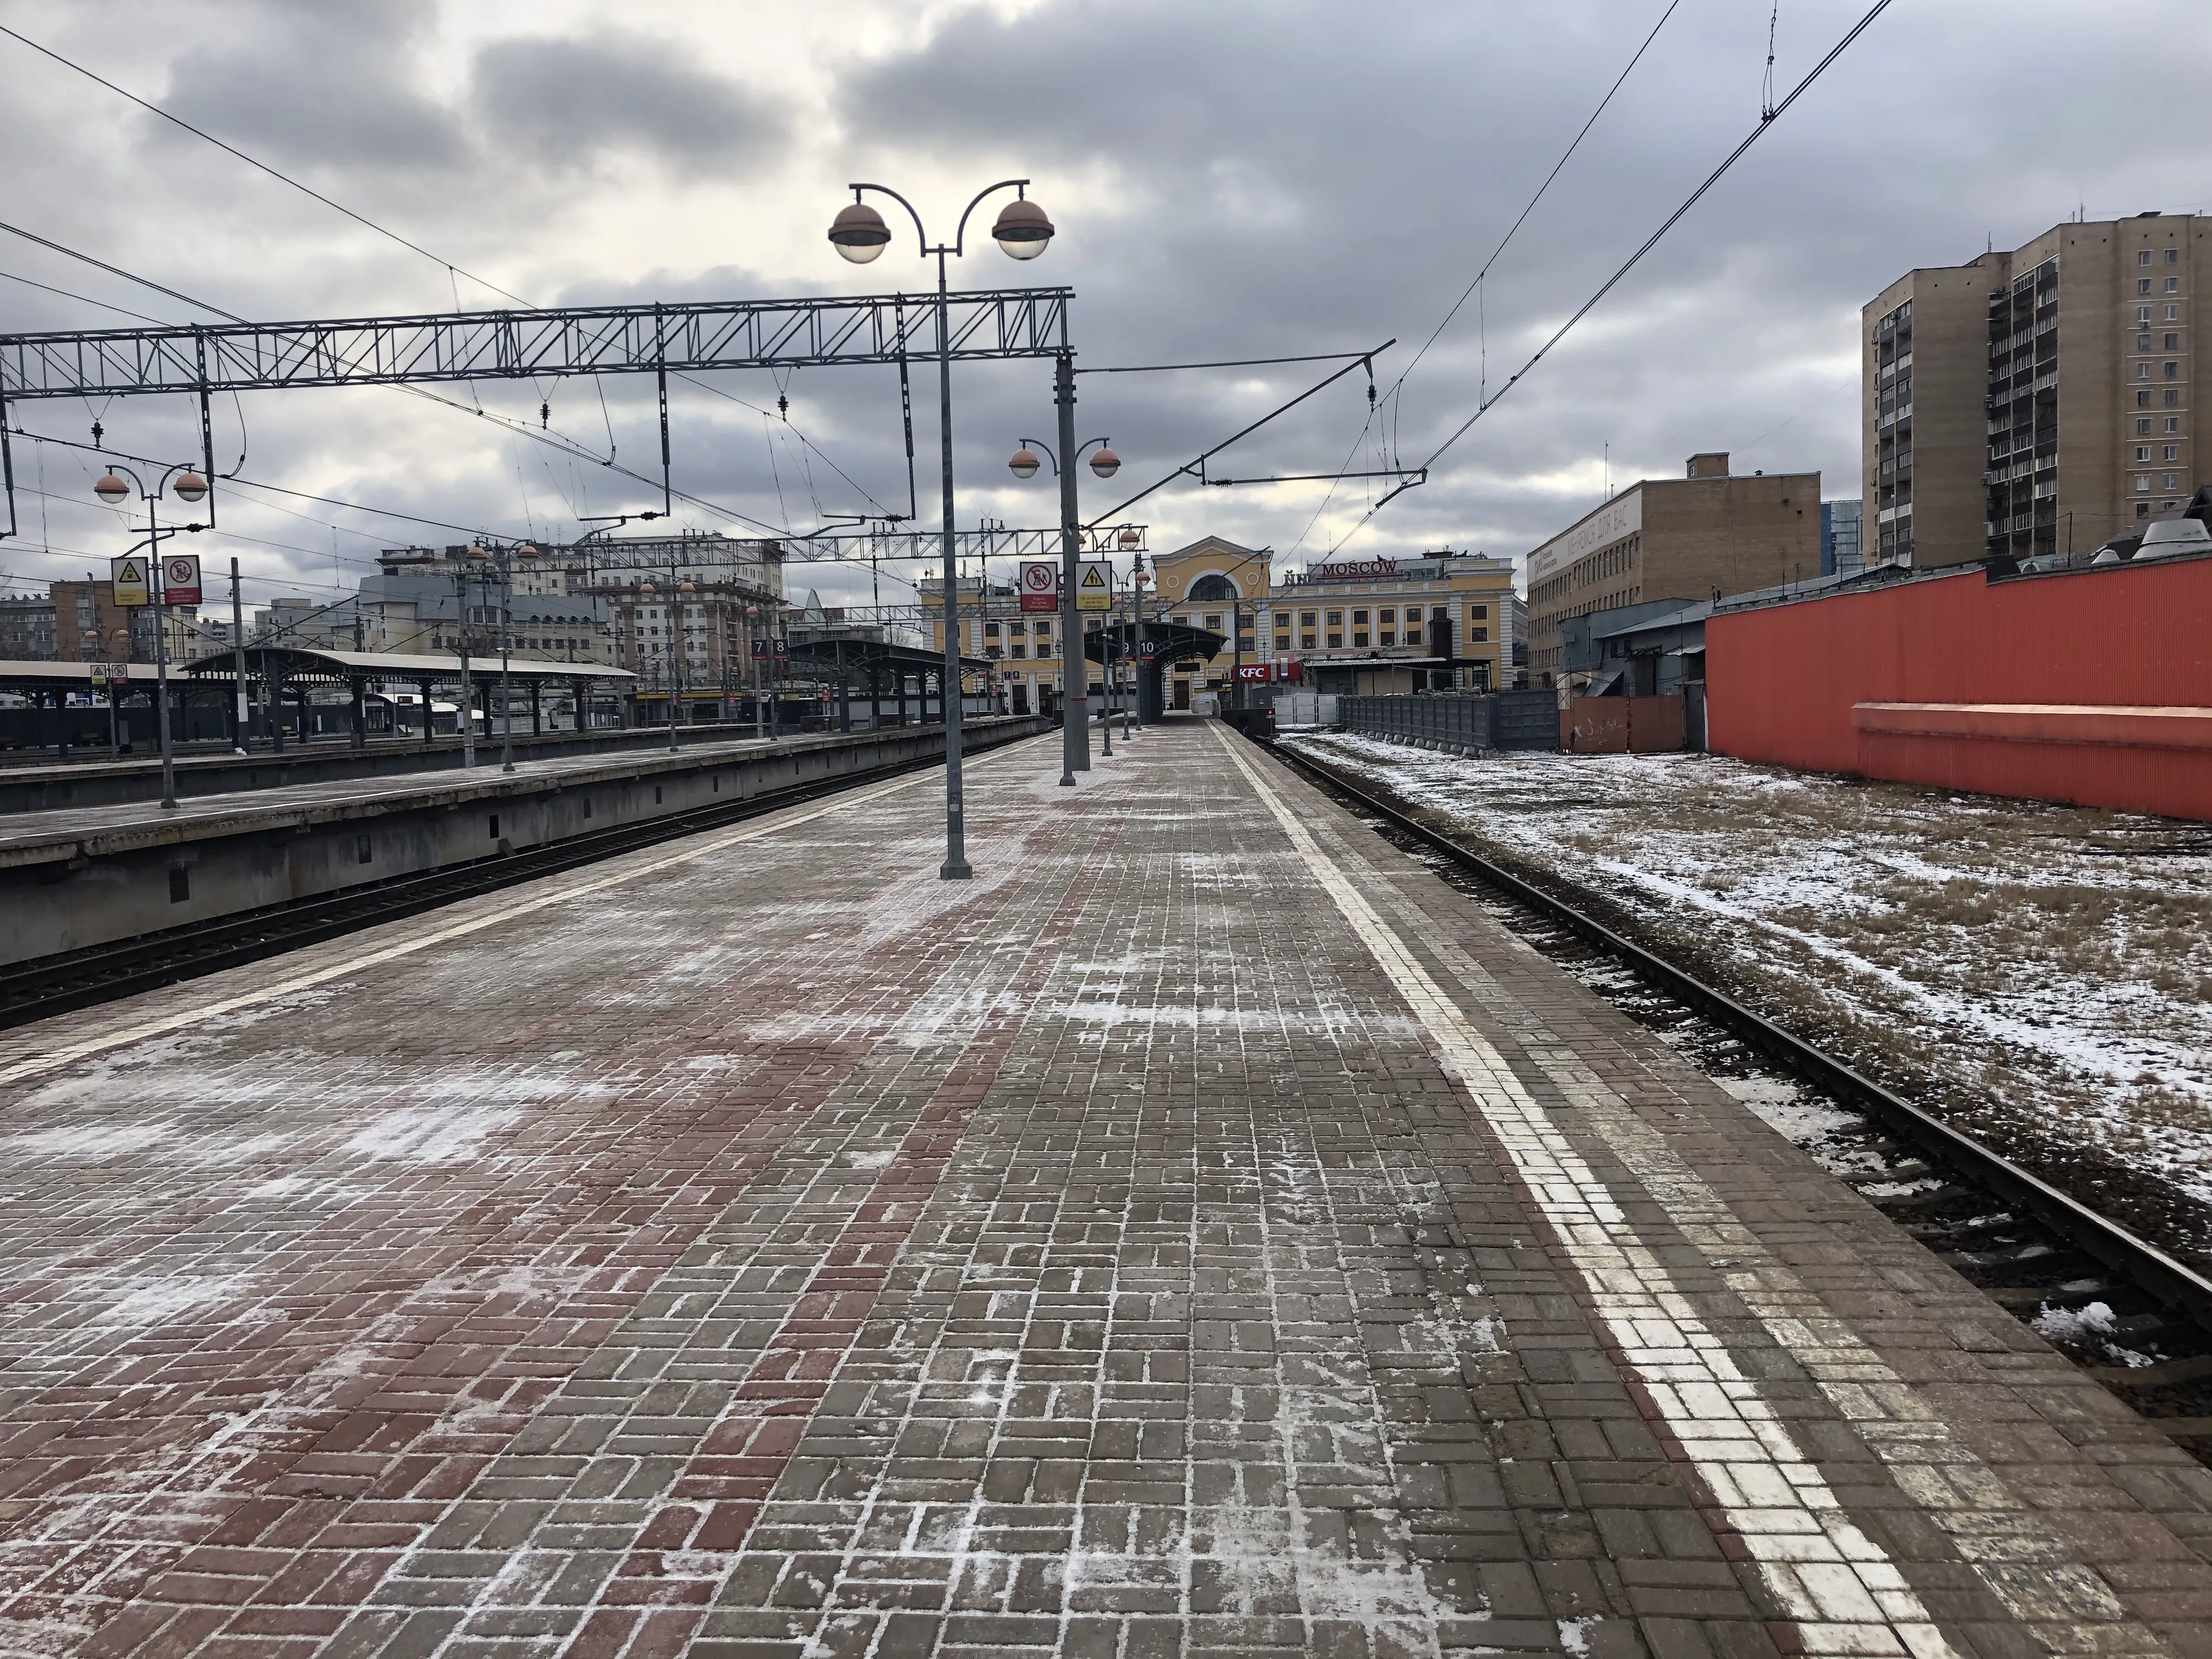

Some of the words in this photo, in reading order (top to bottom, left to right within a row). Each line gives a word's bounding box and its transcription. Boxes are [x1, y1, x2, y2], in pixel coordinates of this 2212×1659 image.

[1598, 514, 1611, 543] ДЛЯ
[1614, 504, 1627, 531] ВАС
[1322, 561, 1397, 575] MOSCOW
[755, 642, 763, 652] 7
[777, 641, 784, 652] 8
[1141, 642, 1154, 653] 10
[1240, 668, 1265, 678] KFC
